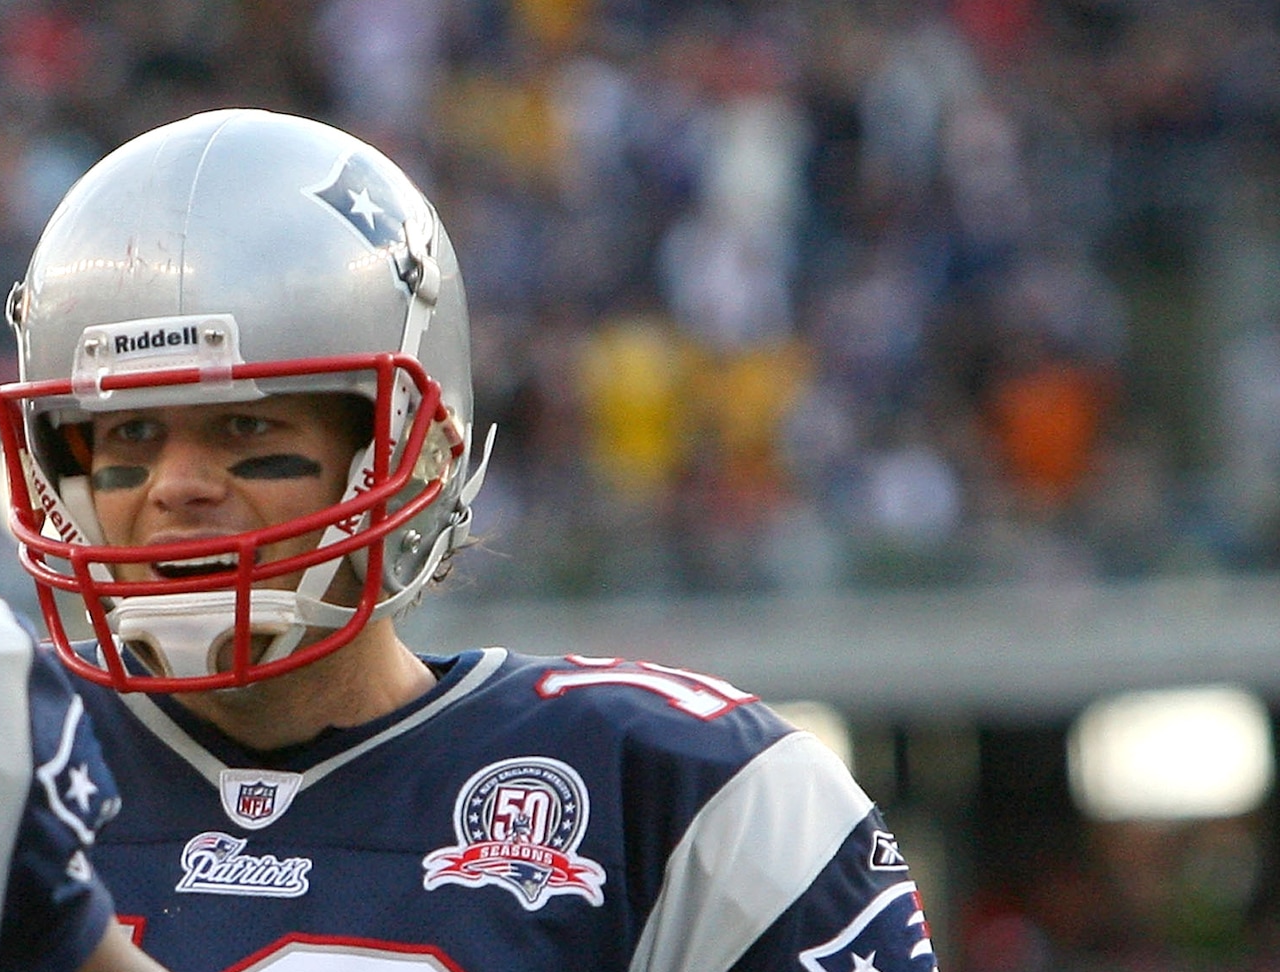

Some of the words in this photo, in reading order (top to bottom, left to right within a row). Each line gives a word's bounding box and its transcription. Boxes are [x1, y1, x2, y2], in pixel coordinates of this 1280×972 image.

[115, 326, 197, 354] Riddell
[241, 796, 272, 815] NFL
[492, 787, 553, 845] 50
[480, 846, 554, 865] SEASONS
[181, 849, 310, 893] Patriots
